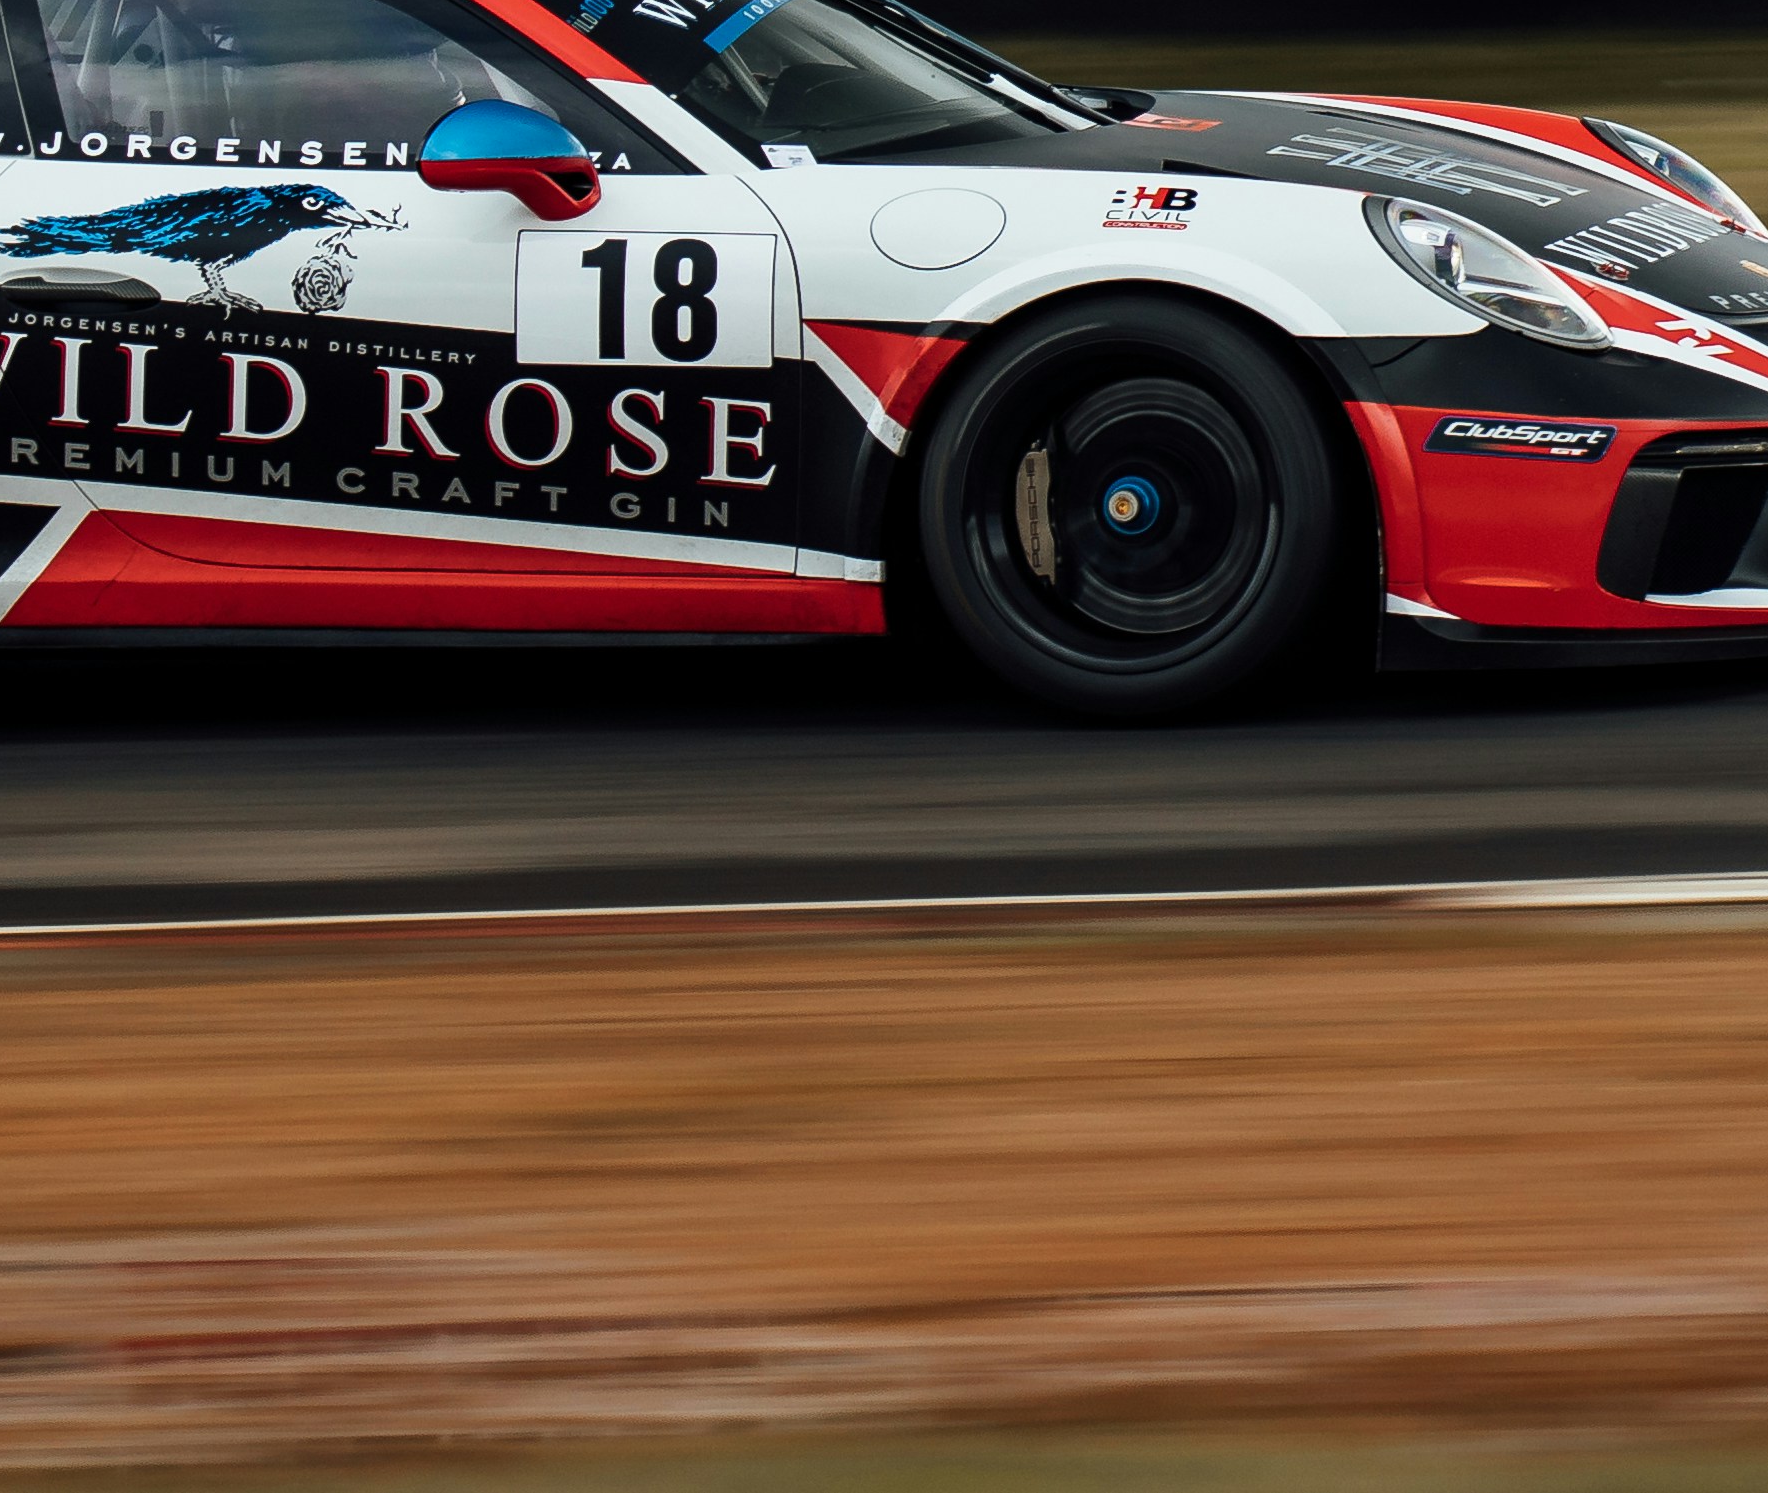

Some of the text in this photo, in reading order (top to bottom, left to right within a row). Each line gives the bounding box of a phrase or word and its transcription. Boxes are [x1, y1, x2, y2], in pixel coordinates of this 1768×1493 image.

[1106, 210, 1190, 222] CIVIL
[1544, 216, 1690, 270] WILD
[581, 238, 718, 362] 18
[8, 312, 477, 365] JORGENSEN'S ARTISAN DISTILLERY
[372, 365, 776, 490] ROSE
[1444, 422, 1607, 444] ClubSport
[336, 467, 568, 512] CRAFT
[610, 492, 728, 527] GIN
[1025, 458, 1041, 568] PORSCHE
